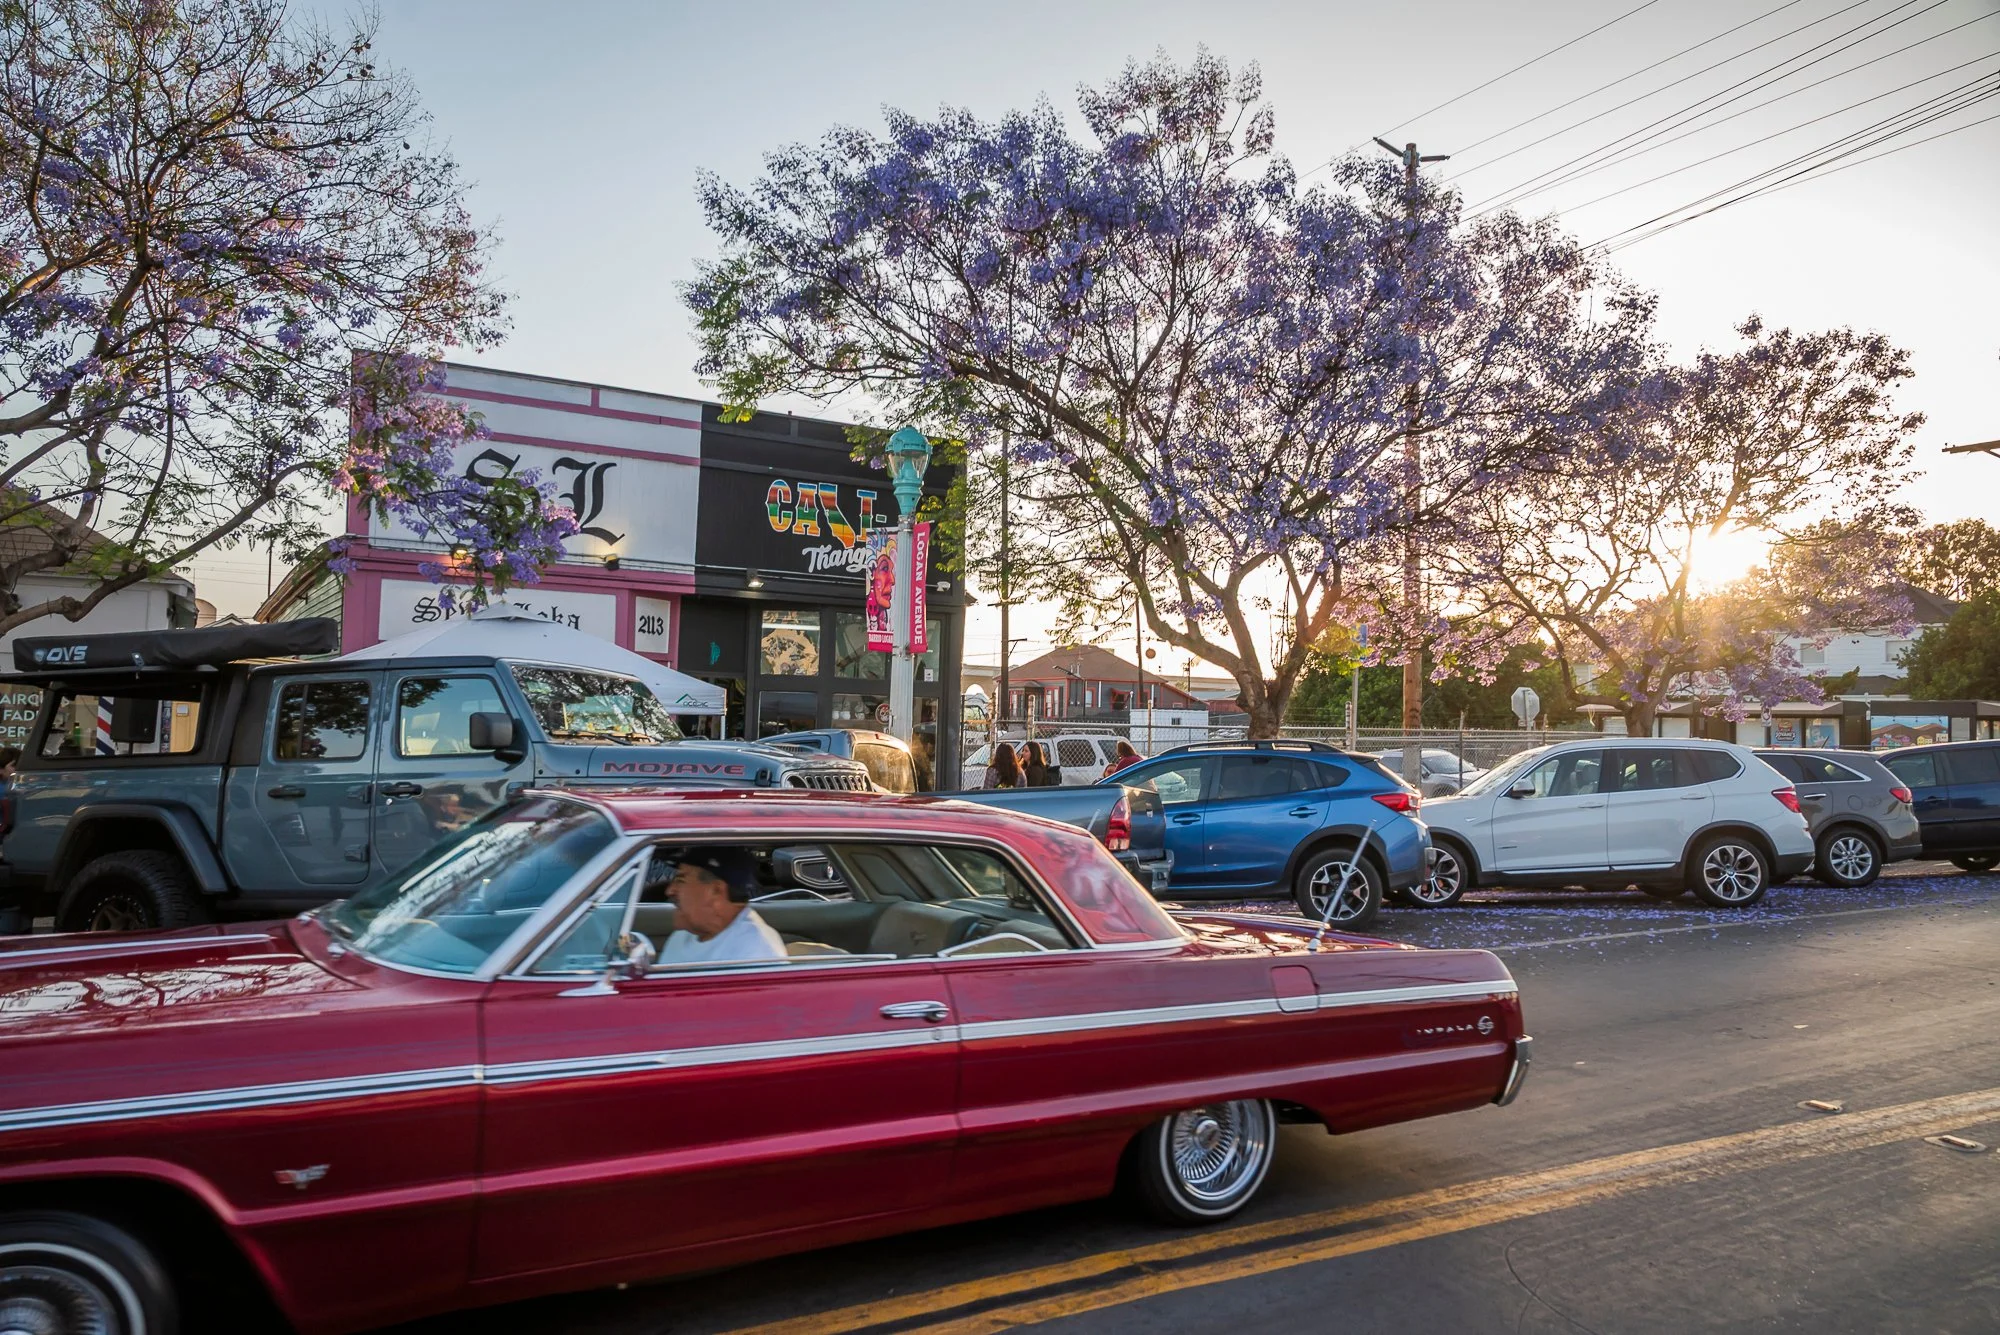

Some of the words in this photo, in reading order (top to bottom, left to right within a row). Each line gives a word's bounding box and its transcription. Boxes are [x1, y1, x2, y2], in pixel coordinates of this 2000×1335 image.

[802, 544, 867, 573] Thang
[915, 531, 925, 581] LOGAN
[638, 615, 664, 636] 2113
[914, 587, 924, 645] AVENUE
[46, 646, 88, 661] OVS
[603, 761, 746, 776] MOJAVE
